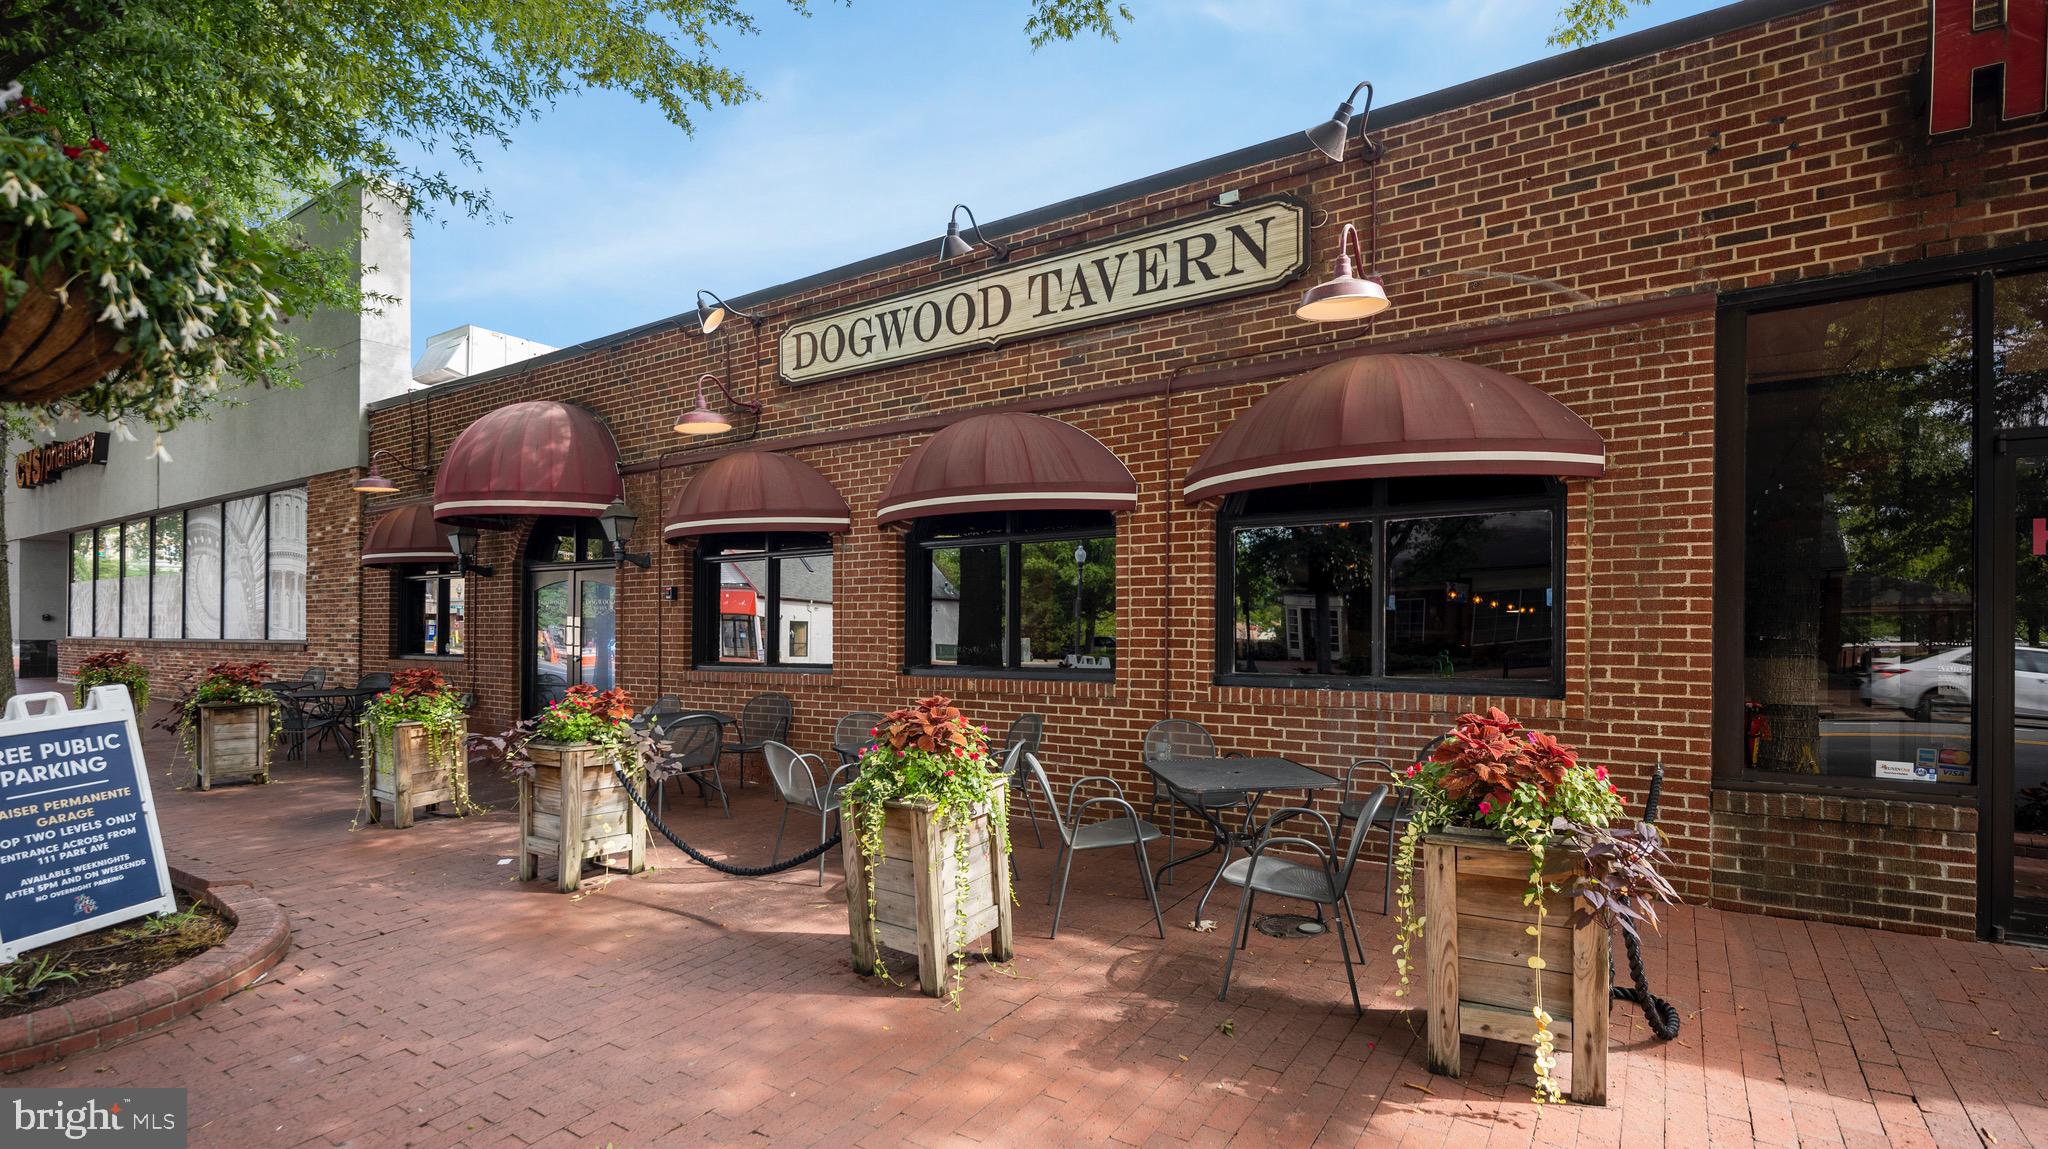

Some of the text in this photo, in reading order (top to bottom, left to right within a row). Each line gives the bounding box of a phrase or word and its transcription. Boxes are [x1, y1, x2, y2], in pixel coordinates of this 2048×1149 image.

[791, 216, 1276, 371] DOGWOOD TAVERN
[39, 733, 121, 760] PUBLIC
[0, 756, 107, 788] PARKING
[1943, 769, 1965, 777] VISA
[44, 787, 131, 812] PERMANENTE
[24, 830, 56, 844] TWO
[60, 819, 102, 837] LEVELS
[105, 812, 137, 826] ONLY
[36, 807, 95, 827] GARAGE
[0, 826, 137, 865] ENTRANCE ACROSS FROM
[38, 842, 110, 865] 111 PARK AVE
[4, 858, 147, 901] AFTER 5PM AND ON WEEKENDS
[20, 853, 130, 887] AVAILABLE WEEKNIGHTS
[35, 874, 125, 902] NO OVERNIGHT PARKING
